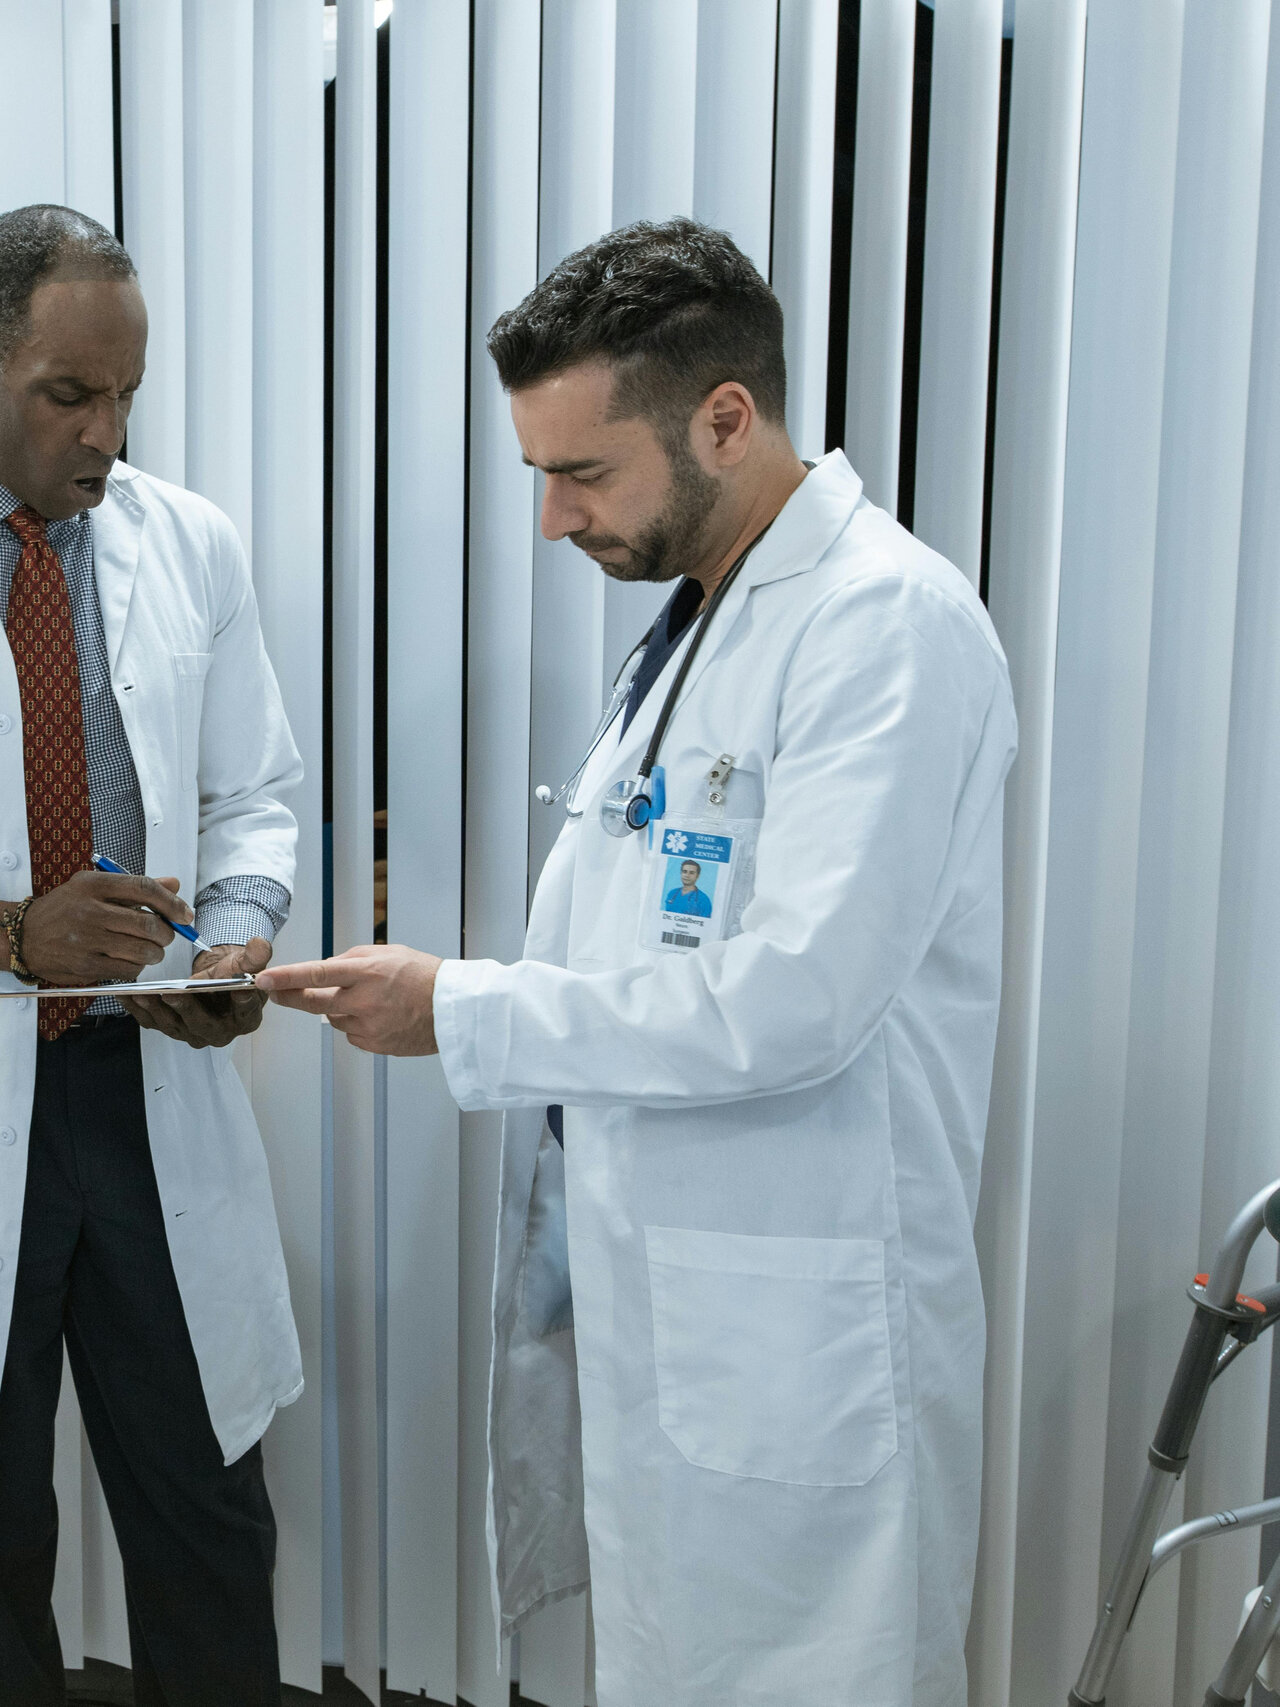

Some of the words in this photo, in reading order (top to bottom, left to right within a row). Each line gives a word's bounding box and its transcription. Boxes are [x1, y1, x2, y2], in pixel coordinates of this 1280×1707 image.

[696, 835, 715, 843] STATE
[695, 843, 725, 852] MEDICAL
[693, 851, 720, 859] CENTER
[662, 913, 672, 921] Dr.
[674, 914, 705, 927] Goldberg
